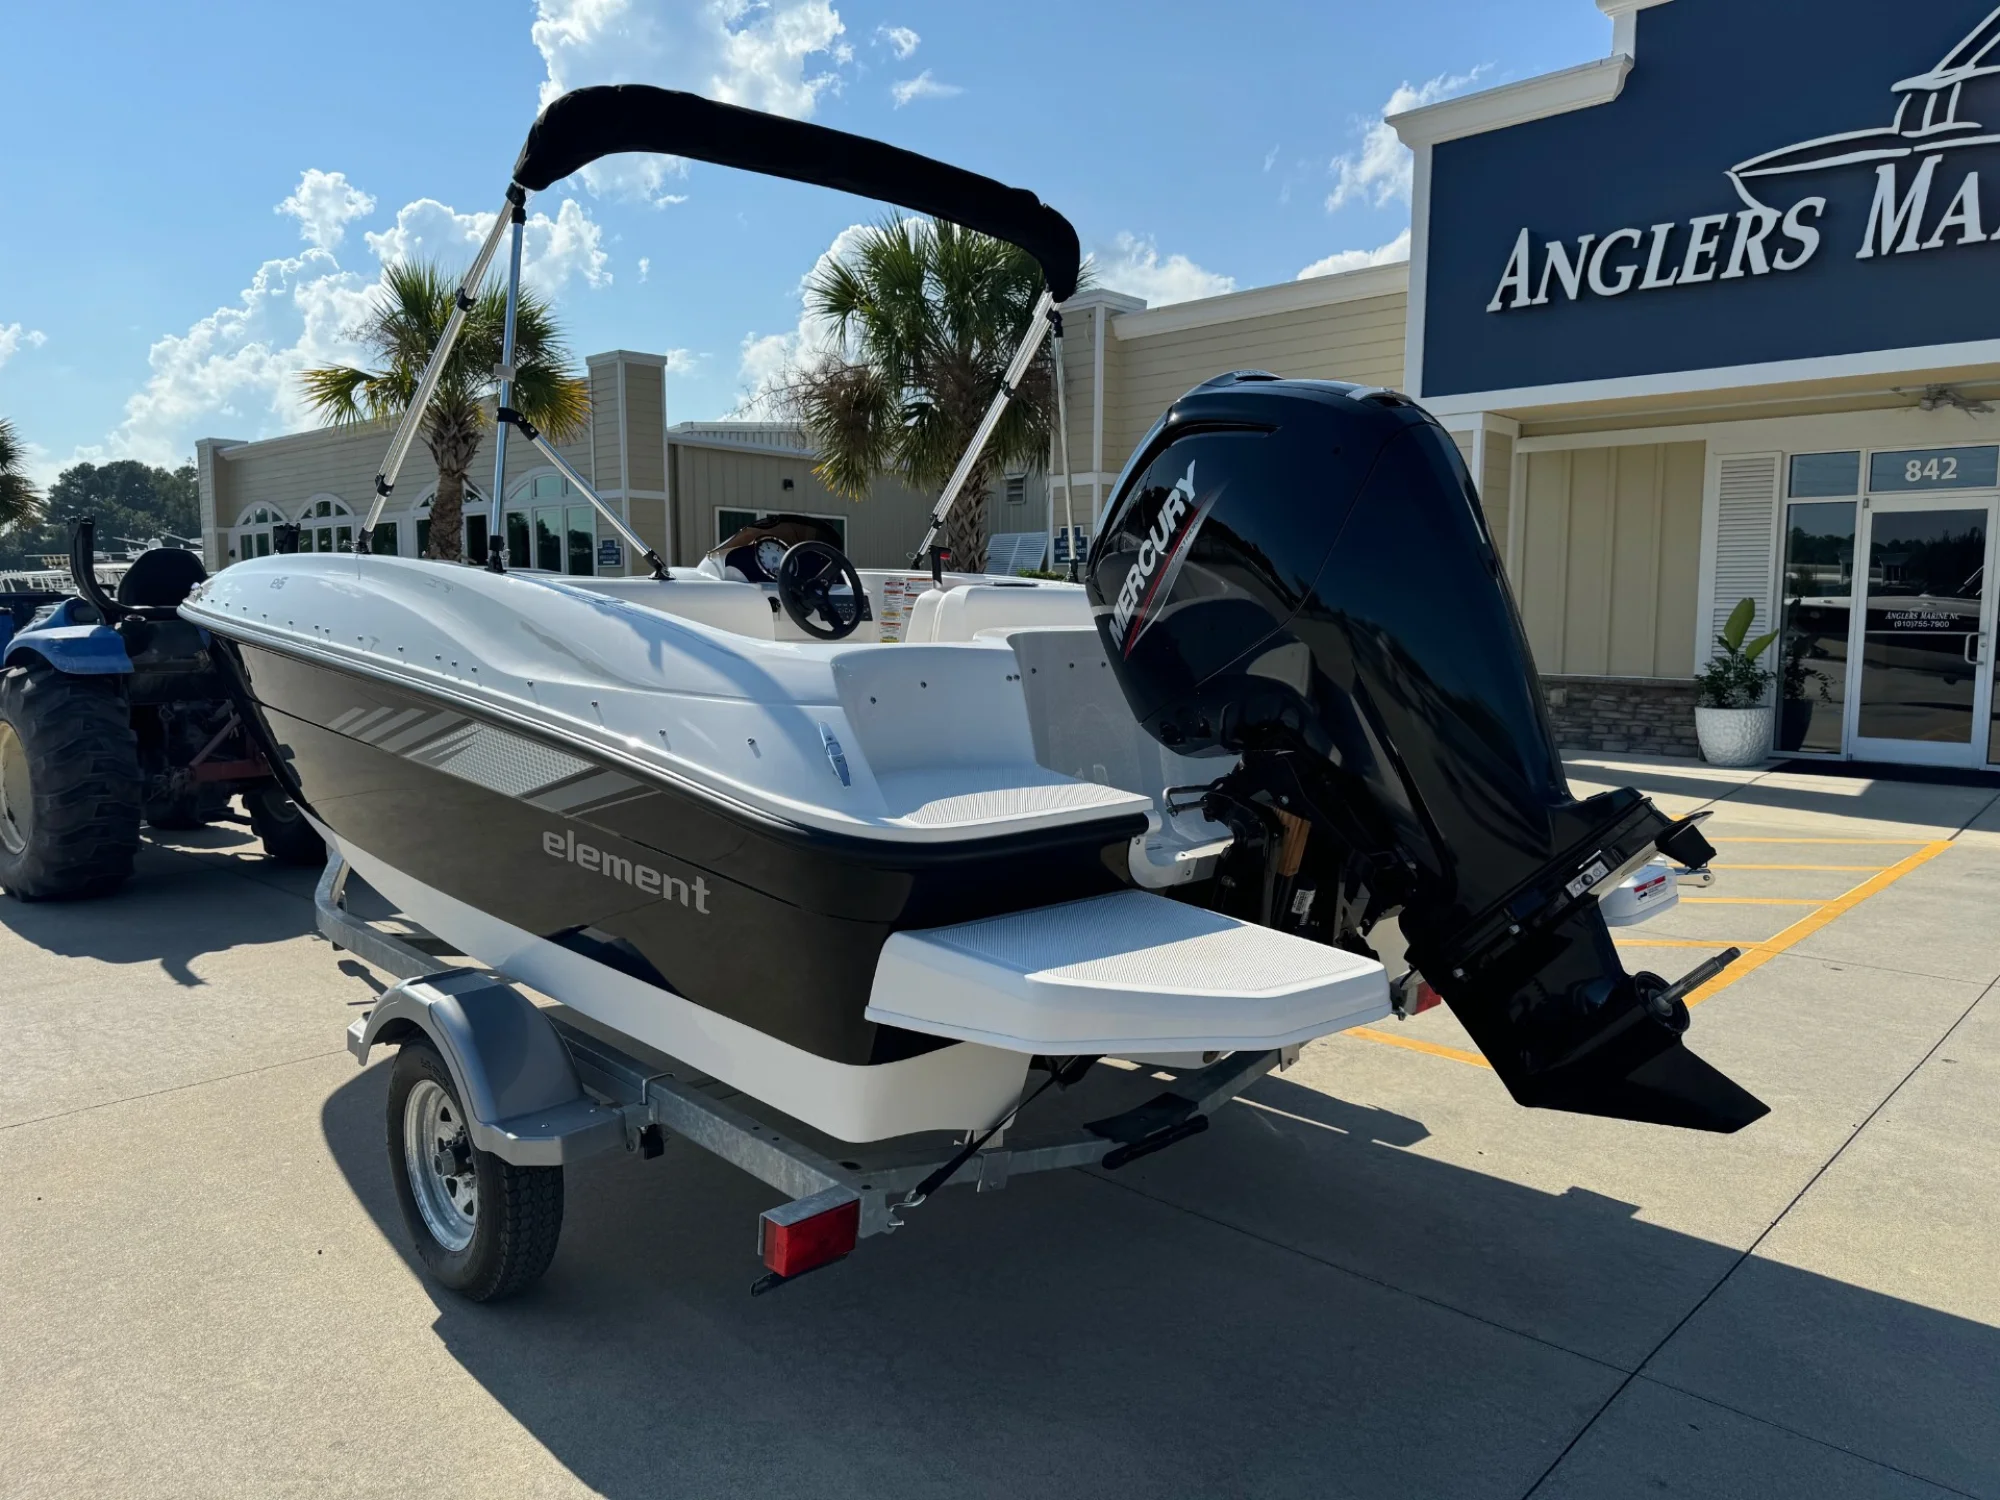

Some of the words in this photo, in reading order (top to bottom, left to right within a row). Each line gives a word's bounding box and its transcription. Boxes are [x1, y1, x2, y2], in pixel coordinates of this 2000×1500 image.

[1486, 197, 1827, 313] ANGLERS
[1855, 154, 2000, 259] MA
[1905, 457, 1957, 482] 842
[1108, 459, 1196, 651] MERCURY
[1885, 611, 1919, 620] ANGLERS
[1920, 611, 1948, 620] MARINE
[1949, 612, 1960, 620] NC
[542, 829, 711, 915] element
